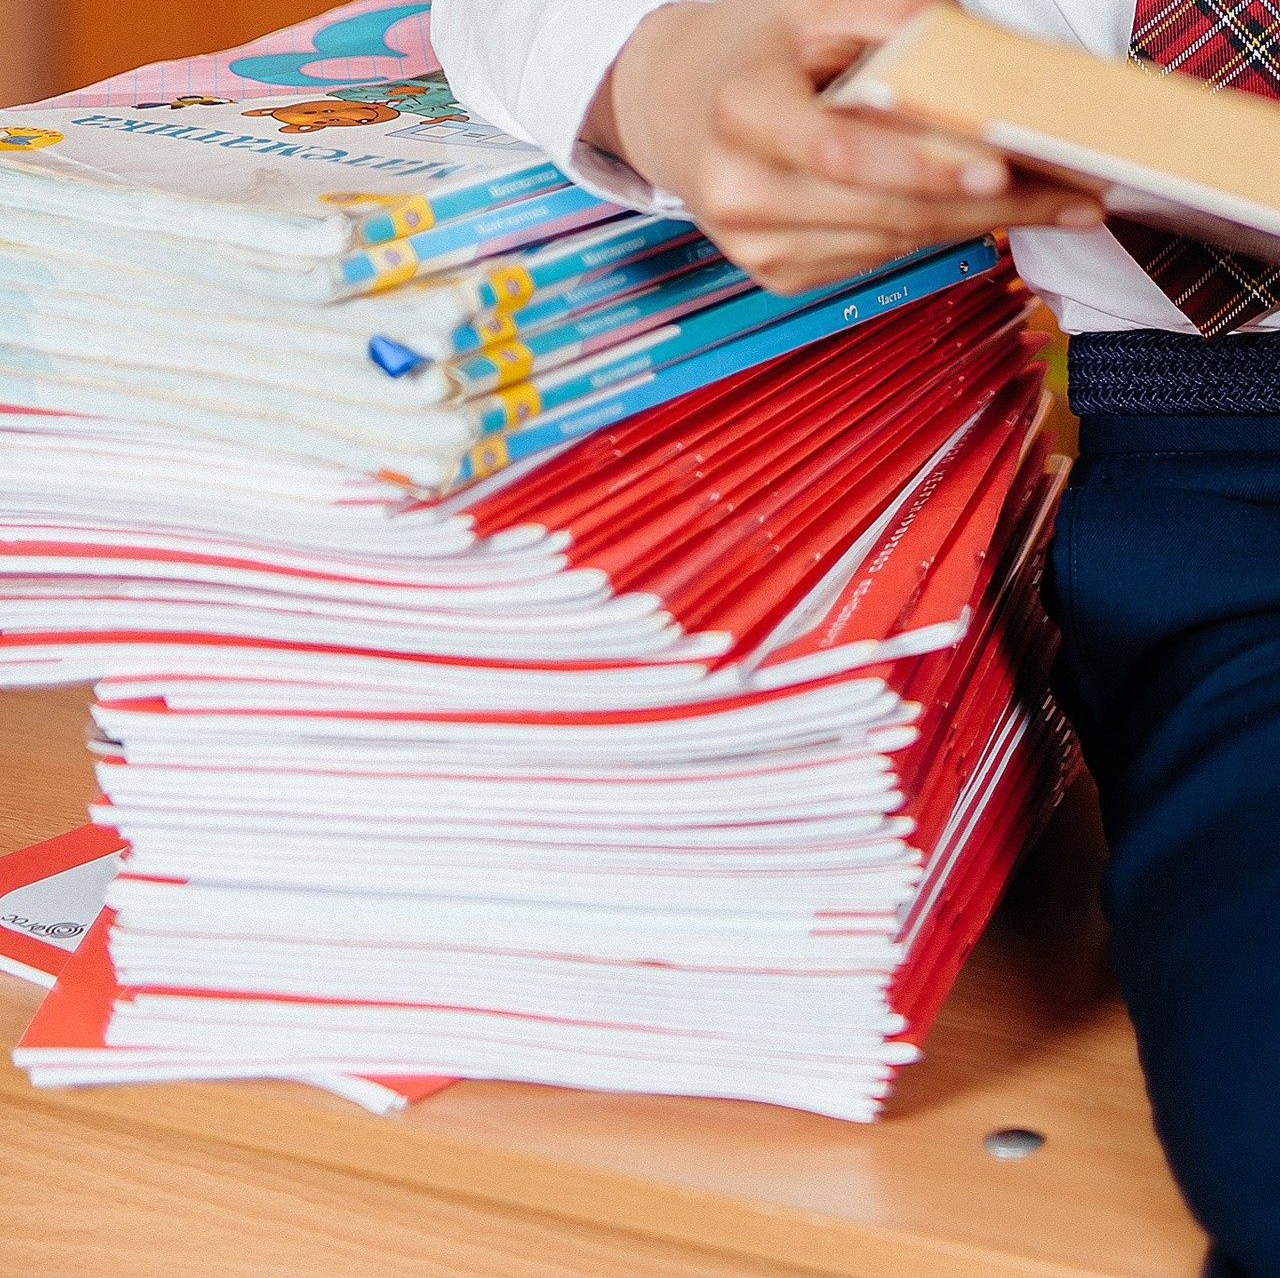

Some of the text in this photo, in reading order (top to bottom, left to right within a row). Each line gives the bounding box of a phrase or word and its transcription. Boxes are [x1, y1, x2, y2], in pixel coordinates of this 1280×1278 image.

[71, 115, 484, 181] Математика
[843, 304, 859, 321] 3
[877, 291, 902, 306] Часть
